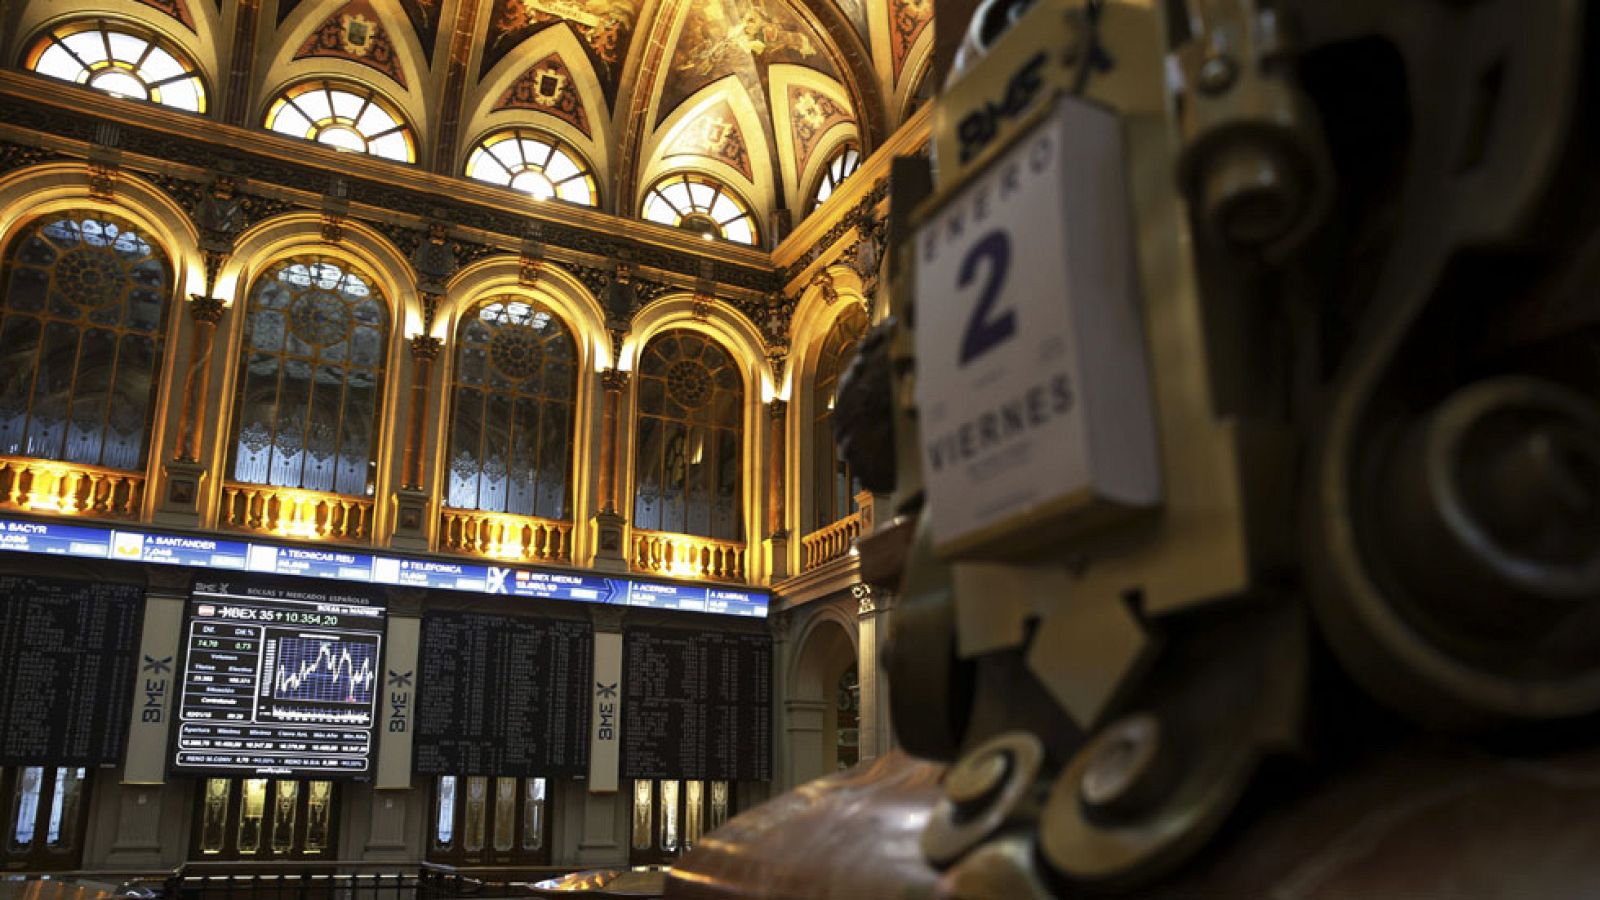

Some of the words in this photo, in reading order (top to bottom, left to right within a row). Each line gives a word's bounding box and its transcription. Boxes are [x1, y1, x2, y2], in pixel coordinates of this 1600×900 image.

[923, 134, 1056, 264] ENERO
[955, 228, 1018, 368] 2
[928, 371, 1075, 473] VIERNES
[8, 522, 48, 535] SACYR
[156, 537, 217, 551] SANTANDER
[288, 549, 334, 561] TECNICAS
[411, 562, 463, 574] TELEFONICA
[247, 587, 276, 597] BOLSAS
[286, 591, 327, 602] MERCADOS
[259, 610, 275, 621] 35
[142, 679, 166, 723] BME
[389, 691, 408, 733] BME
[599, 703, 614, 741] BME
